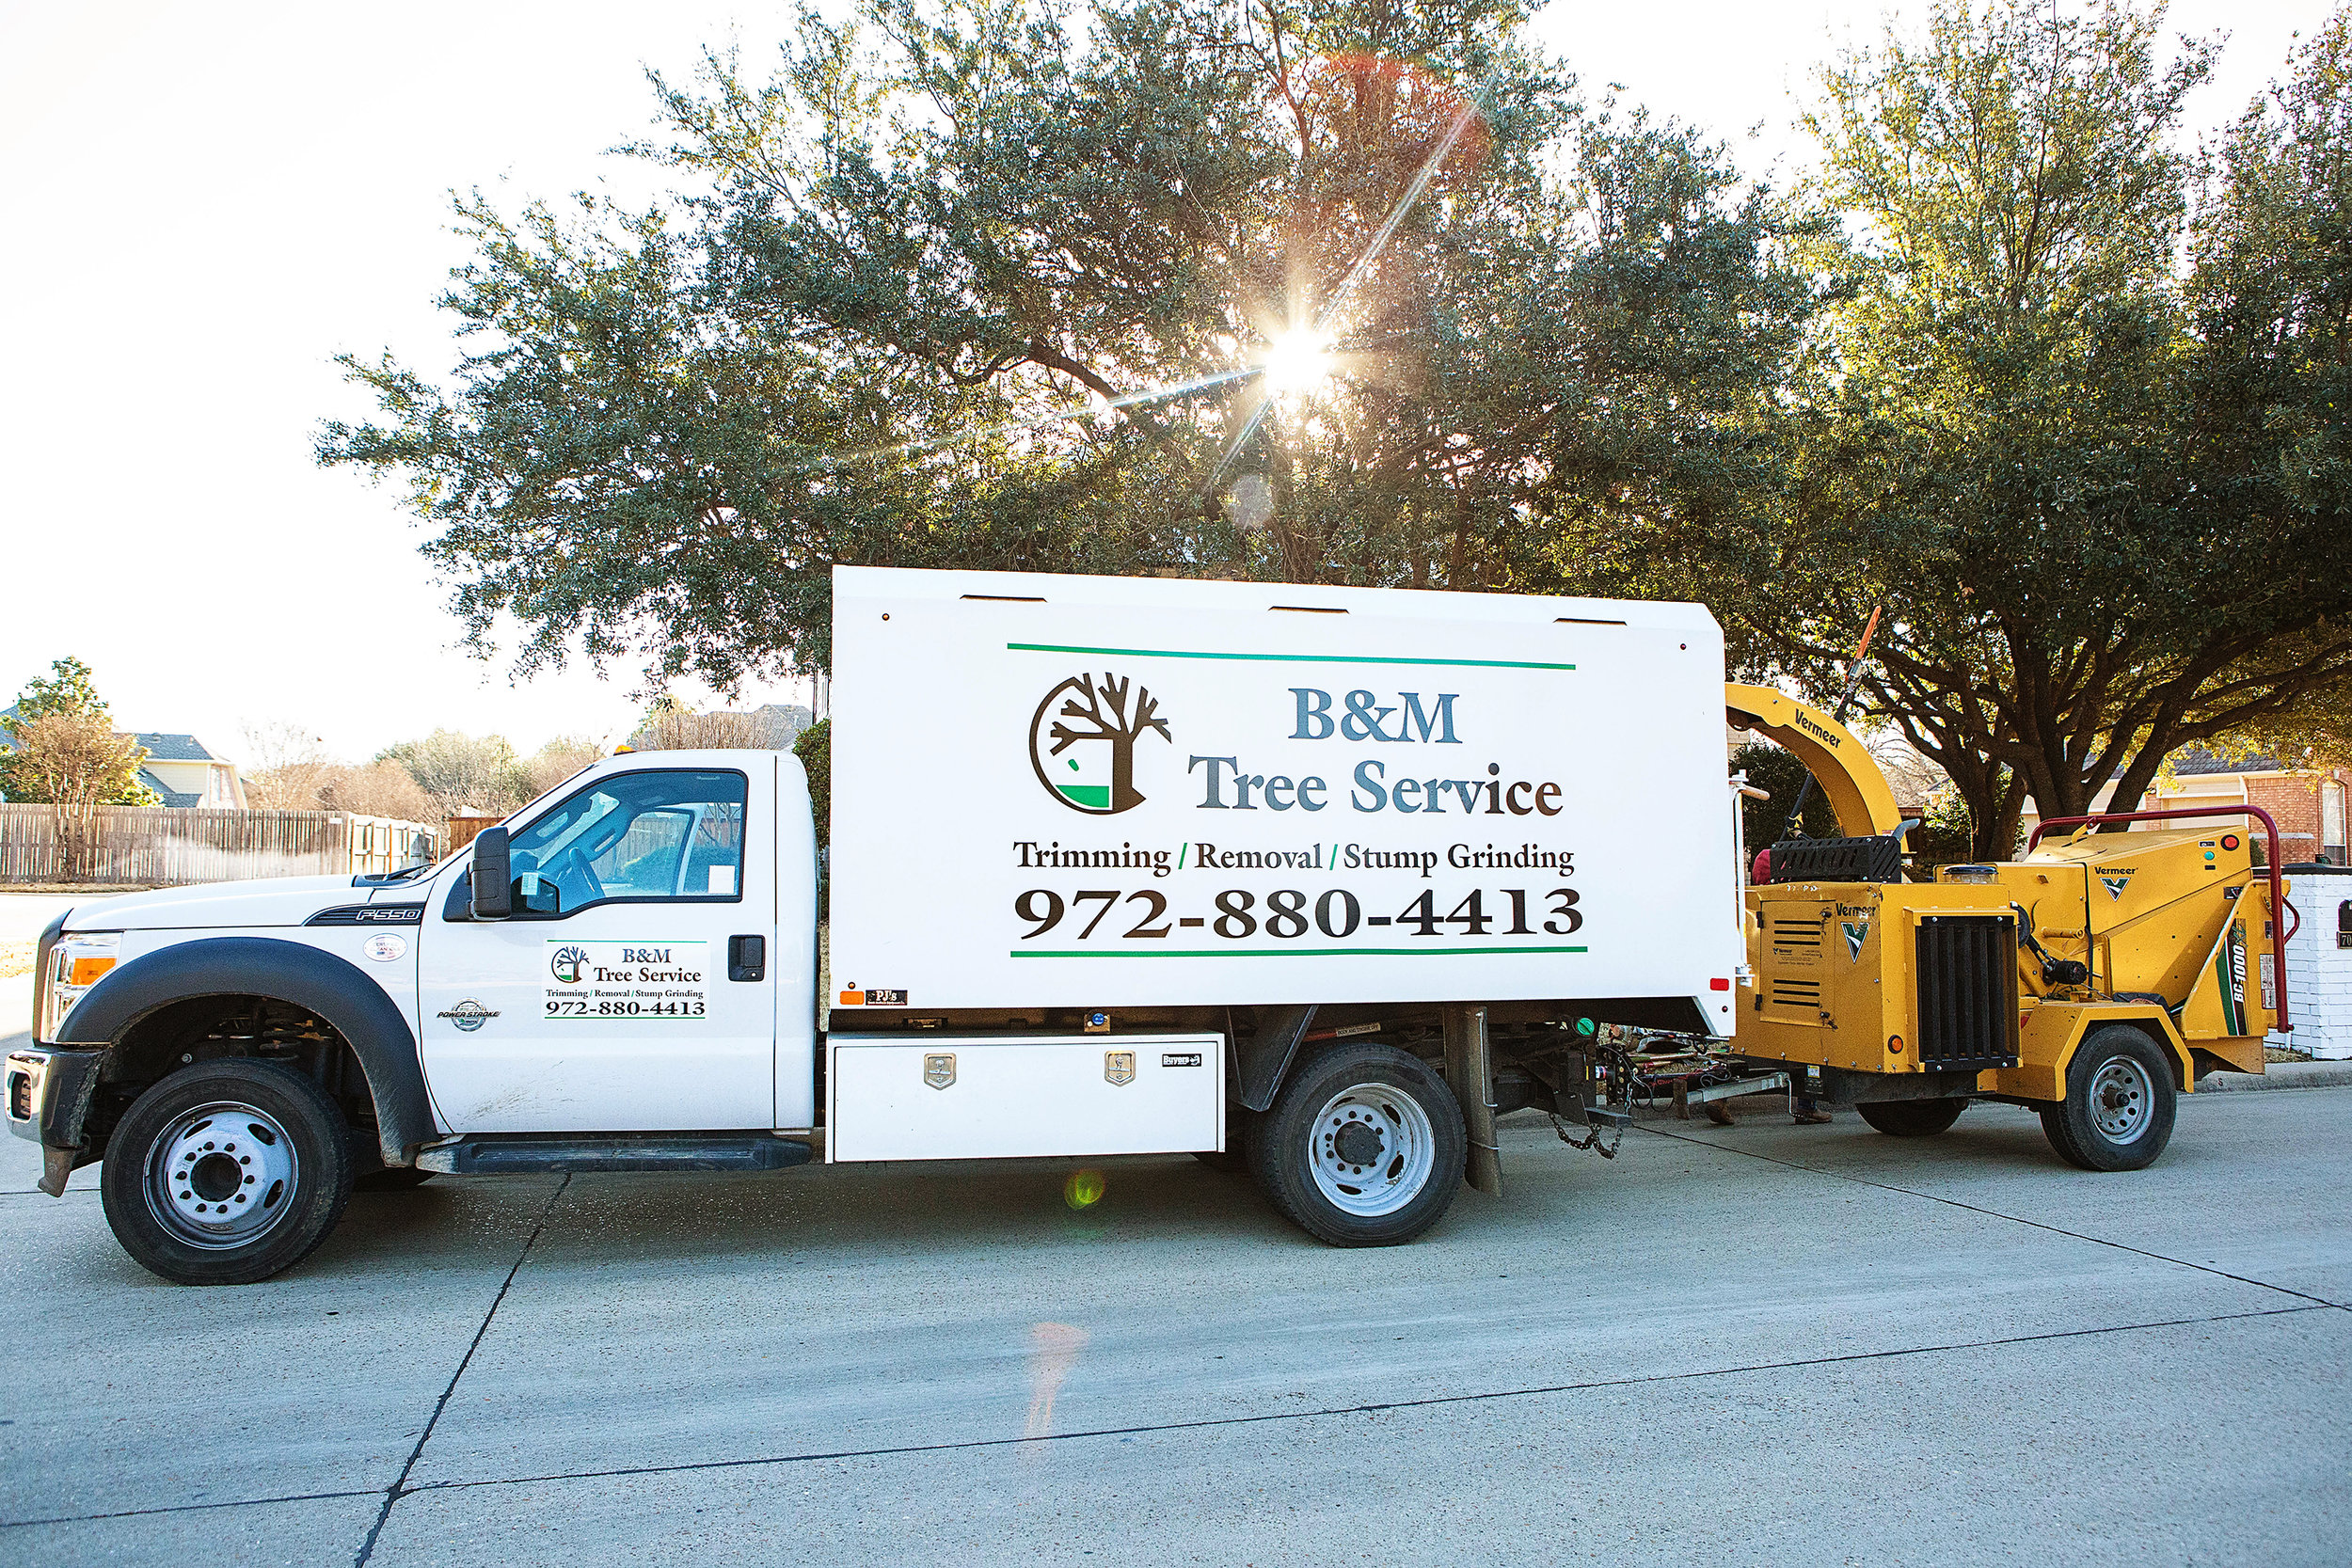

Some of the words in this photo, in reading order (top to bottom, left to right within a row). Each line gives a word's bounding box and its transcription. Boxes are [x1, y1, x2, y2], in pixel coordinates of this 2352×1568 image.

[1288, 689, 1463, 743] B&M
[1795, 707, 1840, 749] Vermeer
[1188, 755, 1327, 811] Tree
[1351, 760, 1563, 816] Service
[1013, 842, 1172, 879] Trimming
[1195, 843, 1324, 870] Removal
[1344, 844, 1438, 879] Stump
[1448, 844, 1575, 878] Grinding
[2094, 866, 2137, 875] Vermeer
[356, 910, 421, 921] F-550
[1015, 885, 1583, 941] 972-880-4413
[1836, 903, 1876, 917] Vermeer
[622, 948, 672, 964] B&M
[594, 967, 633, 982] Tree
[638, 967, 702, 983] Service
[546, 989, 588, 1000] Trimming
[595, 990, 630, 998] Removal
[636, 990, 663, 1000] Stump
[664, 989, 704, 1000] Grinding
[876, 990, 898, 1002] PJ's
[546, 1001, 706, 1016] 972-880-4413
[1163, 1055, 1190, 1066] Buyers
